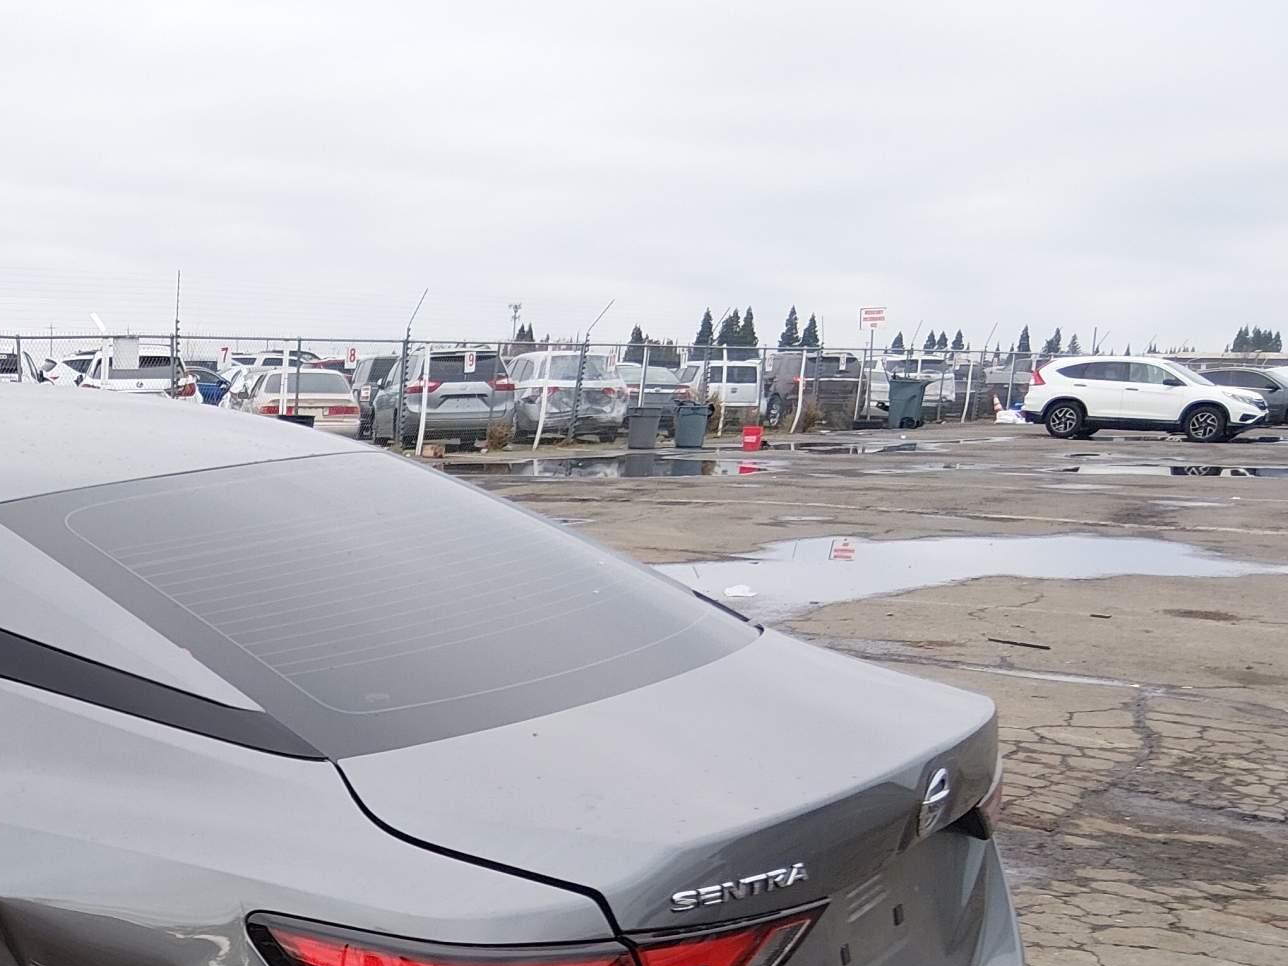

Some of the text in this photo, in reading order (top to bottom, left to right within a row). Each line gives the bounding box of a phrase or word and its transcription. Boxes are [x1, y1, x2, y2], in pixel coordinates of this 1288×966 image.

[221, 347, 229, 364] 7
[349, 347, 356, 363] 8
[468, 352, 475, 367] 9
[670, 862, 809, 912] SENTRA
